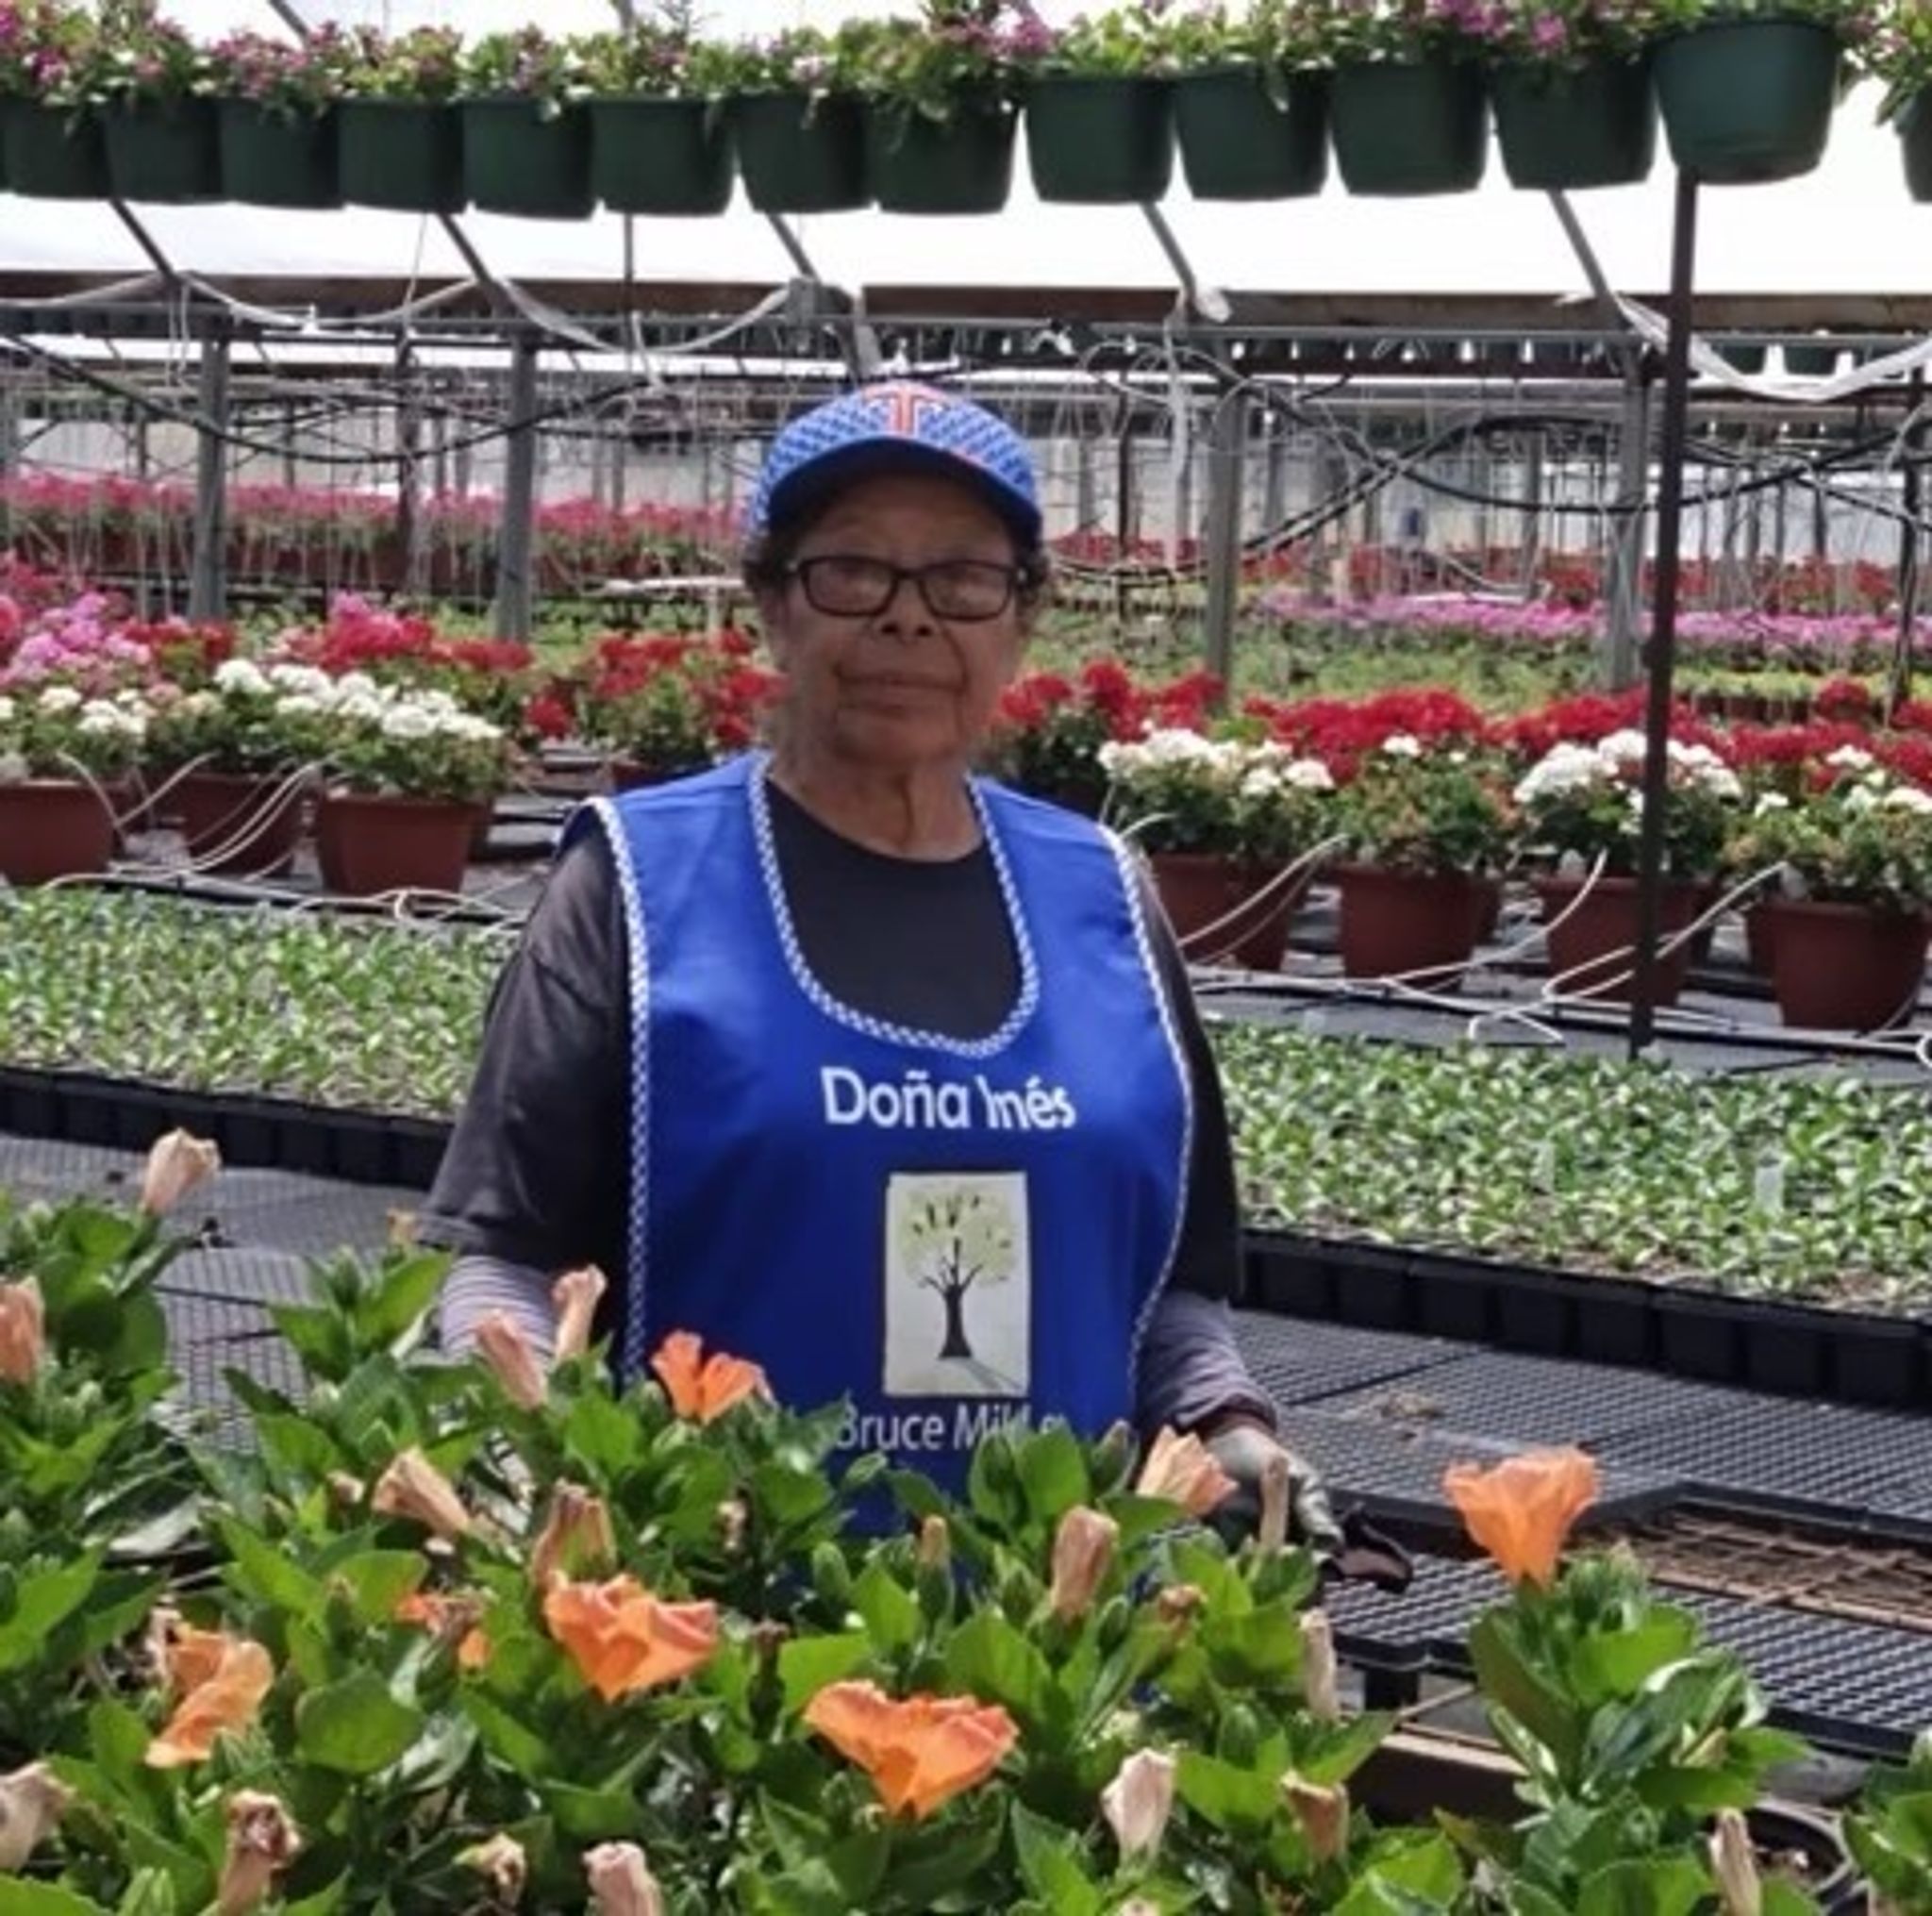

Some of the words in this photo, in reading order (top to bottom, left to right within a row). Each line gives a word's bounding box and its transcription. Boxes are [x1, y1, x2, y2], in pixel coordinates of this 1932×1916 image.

[861, 380, 947, 437] T
[821, 1067, 970, 1127] Doña
[974, 1075, 1076, 1128] Inés
